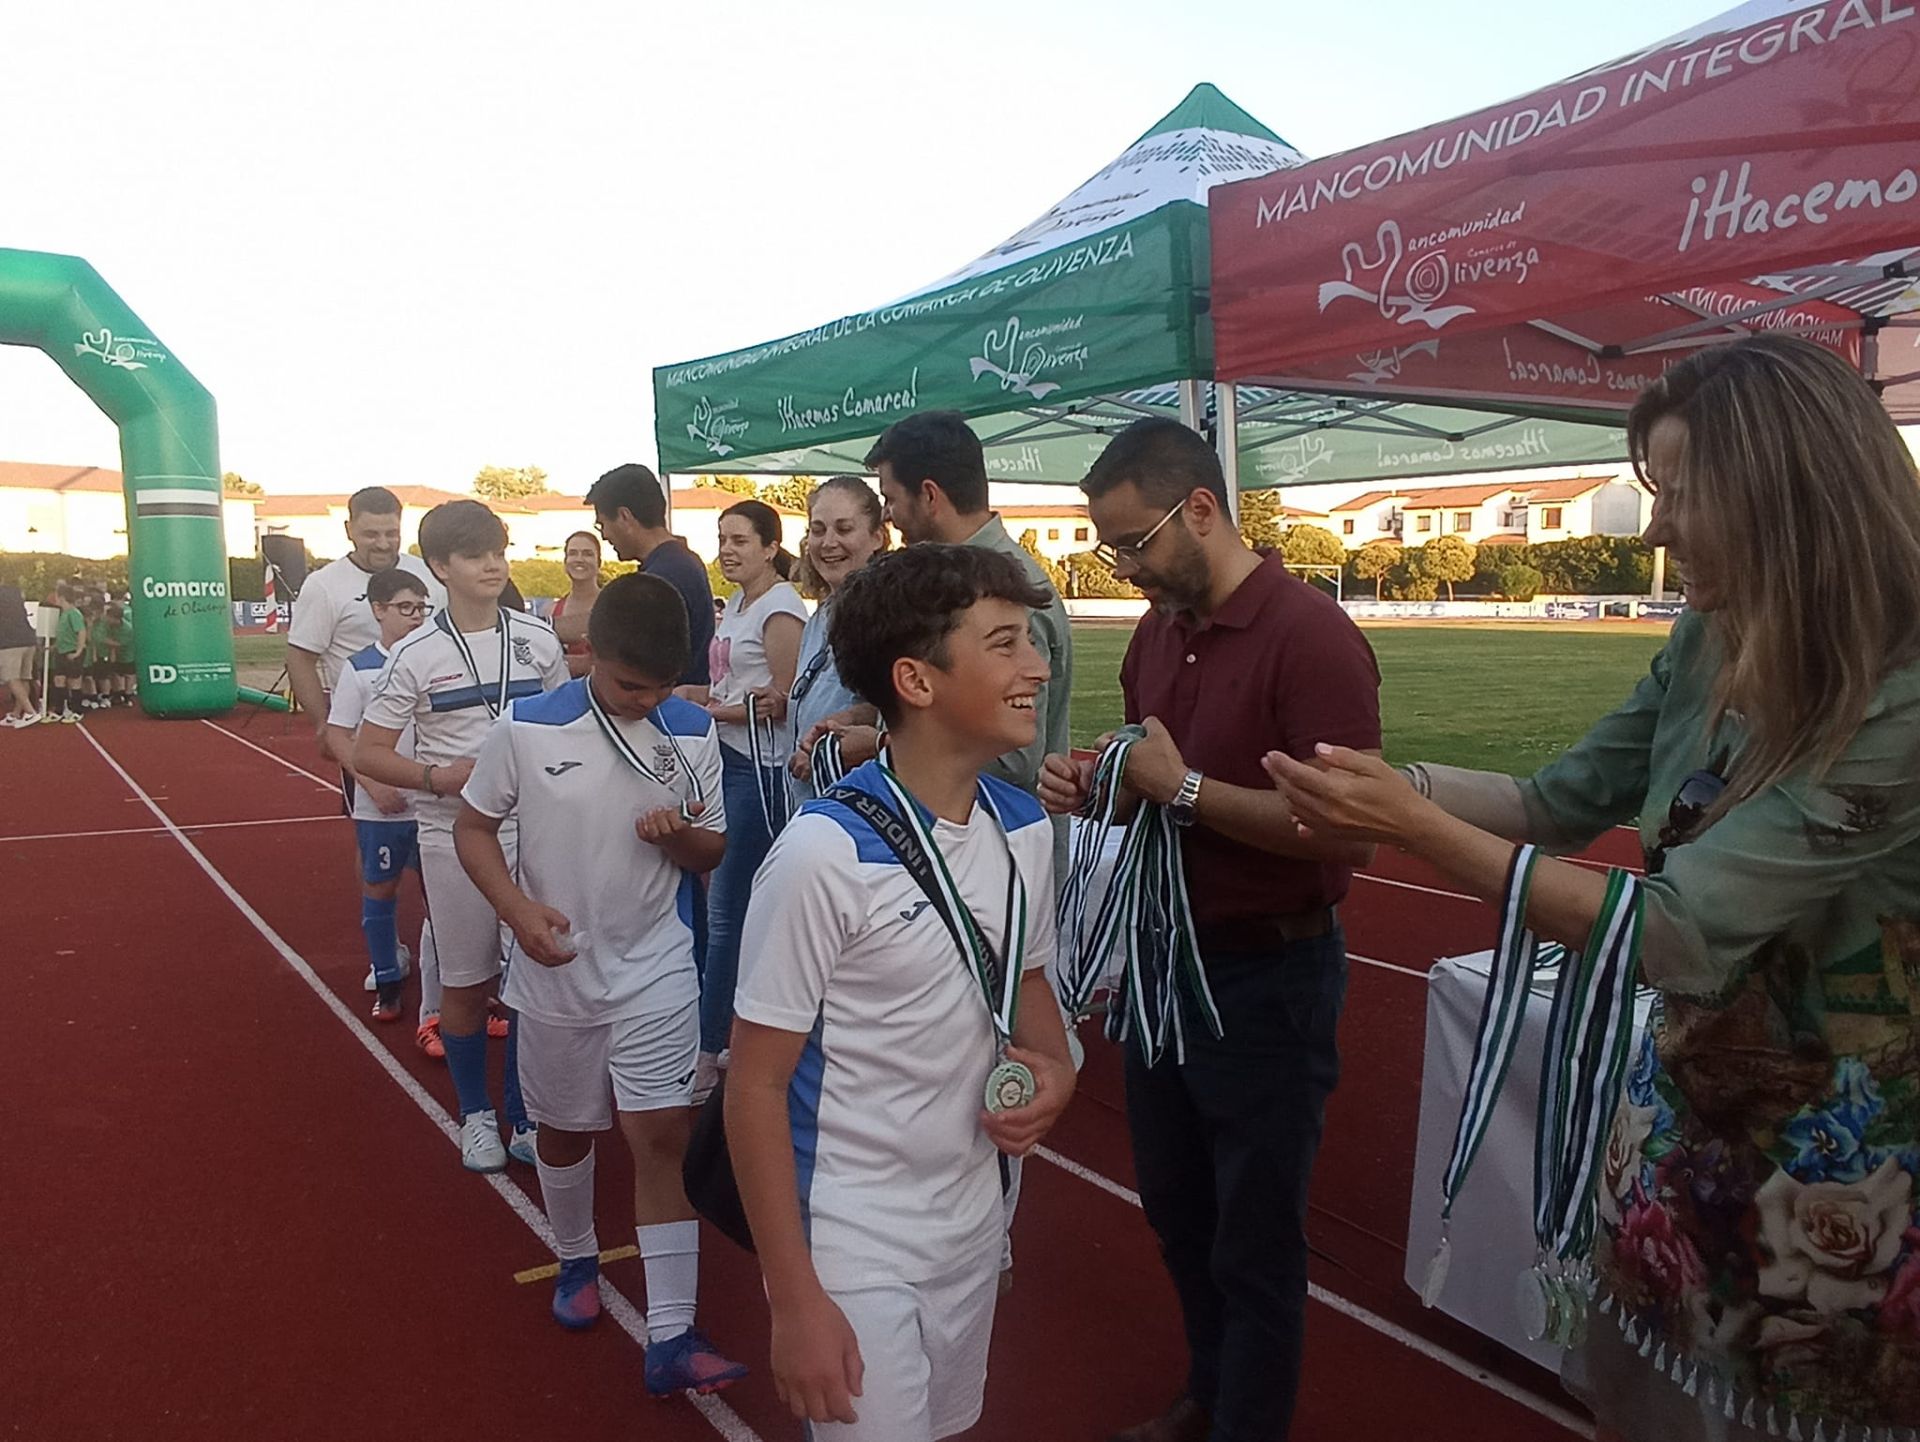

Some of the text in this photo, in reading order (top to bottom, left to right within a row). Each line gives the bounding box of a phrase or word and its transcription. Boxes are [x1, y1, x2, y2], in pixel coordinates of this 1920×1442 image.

[1256, 0, 1915, 229] MANCOMUNIDAD INTEGRAL
[1678, 161, 1918, 252] ¡Hacemo
[1014, 231, 1135, 287] OLIVENZA
[777, 394, 839, 433] ¡Hacemos
[842, 366, 919, 417] Comarca!
[142, 576, 226, 599] Comarca
[378, 845, 391, 870] 3
